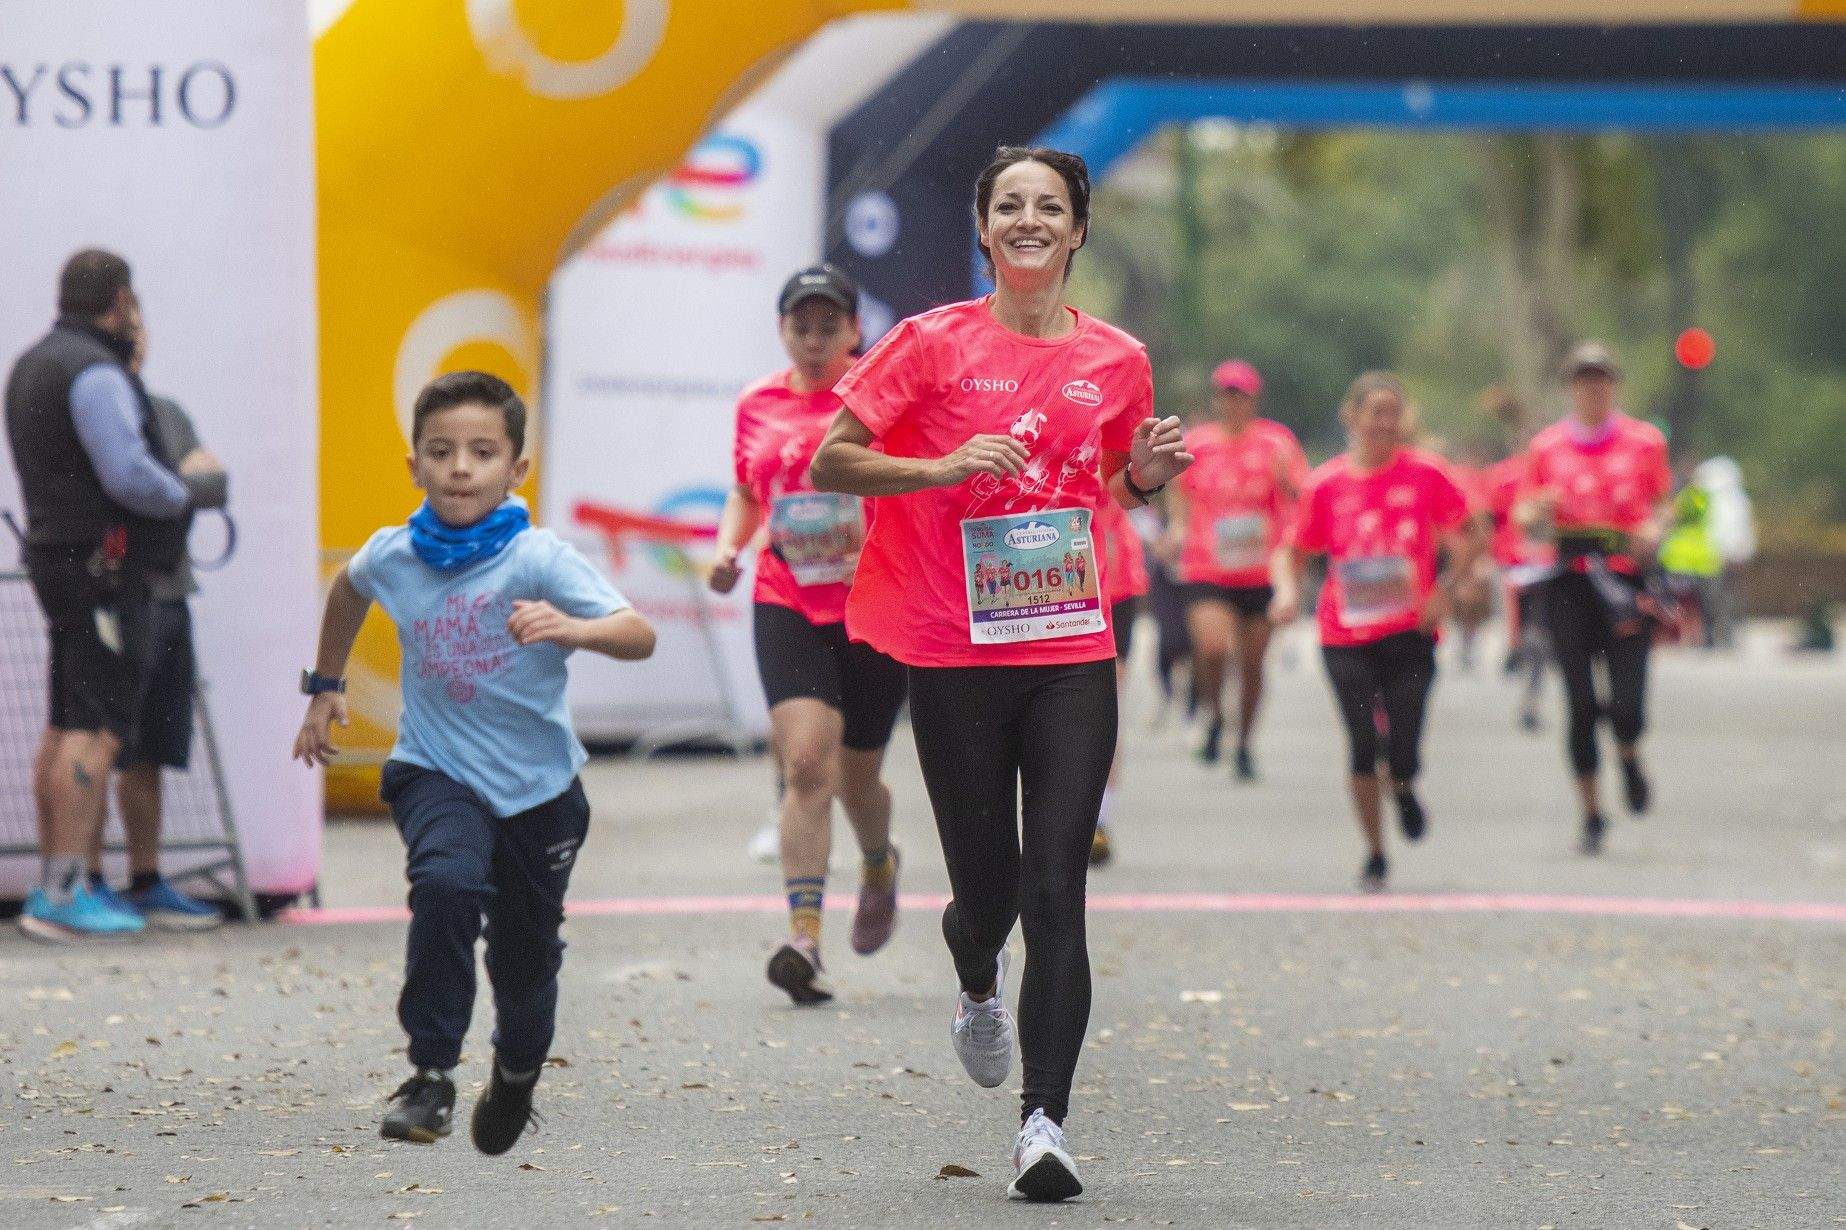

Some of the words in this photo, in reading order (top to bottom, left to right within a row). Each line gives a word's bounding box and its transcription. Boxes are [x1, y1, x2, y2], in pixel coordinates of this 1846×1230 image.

[961, 378, 1018, 393] OYSHO
[1007, 531, 1057, 546] ASTURIANA
[1013, 567, 1062, 591] 016
[1027, 594, 1051, 605] 1512
[990, 608, 1020, 619] CARRERA
[1020, 607, 1030, 616] DE
[1030, 606, 1039, 615] LA
[1039, 604, 1060, 614] MUJER
[1063, 601, 1087, 611] SEVILLA
[987, 622, 1030, 637] OYSHO
[1055, 618, 1091, 630] Santander
